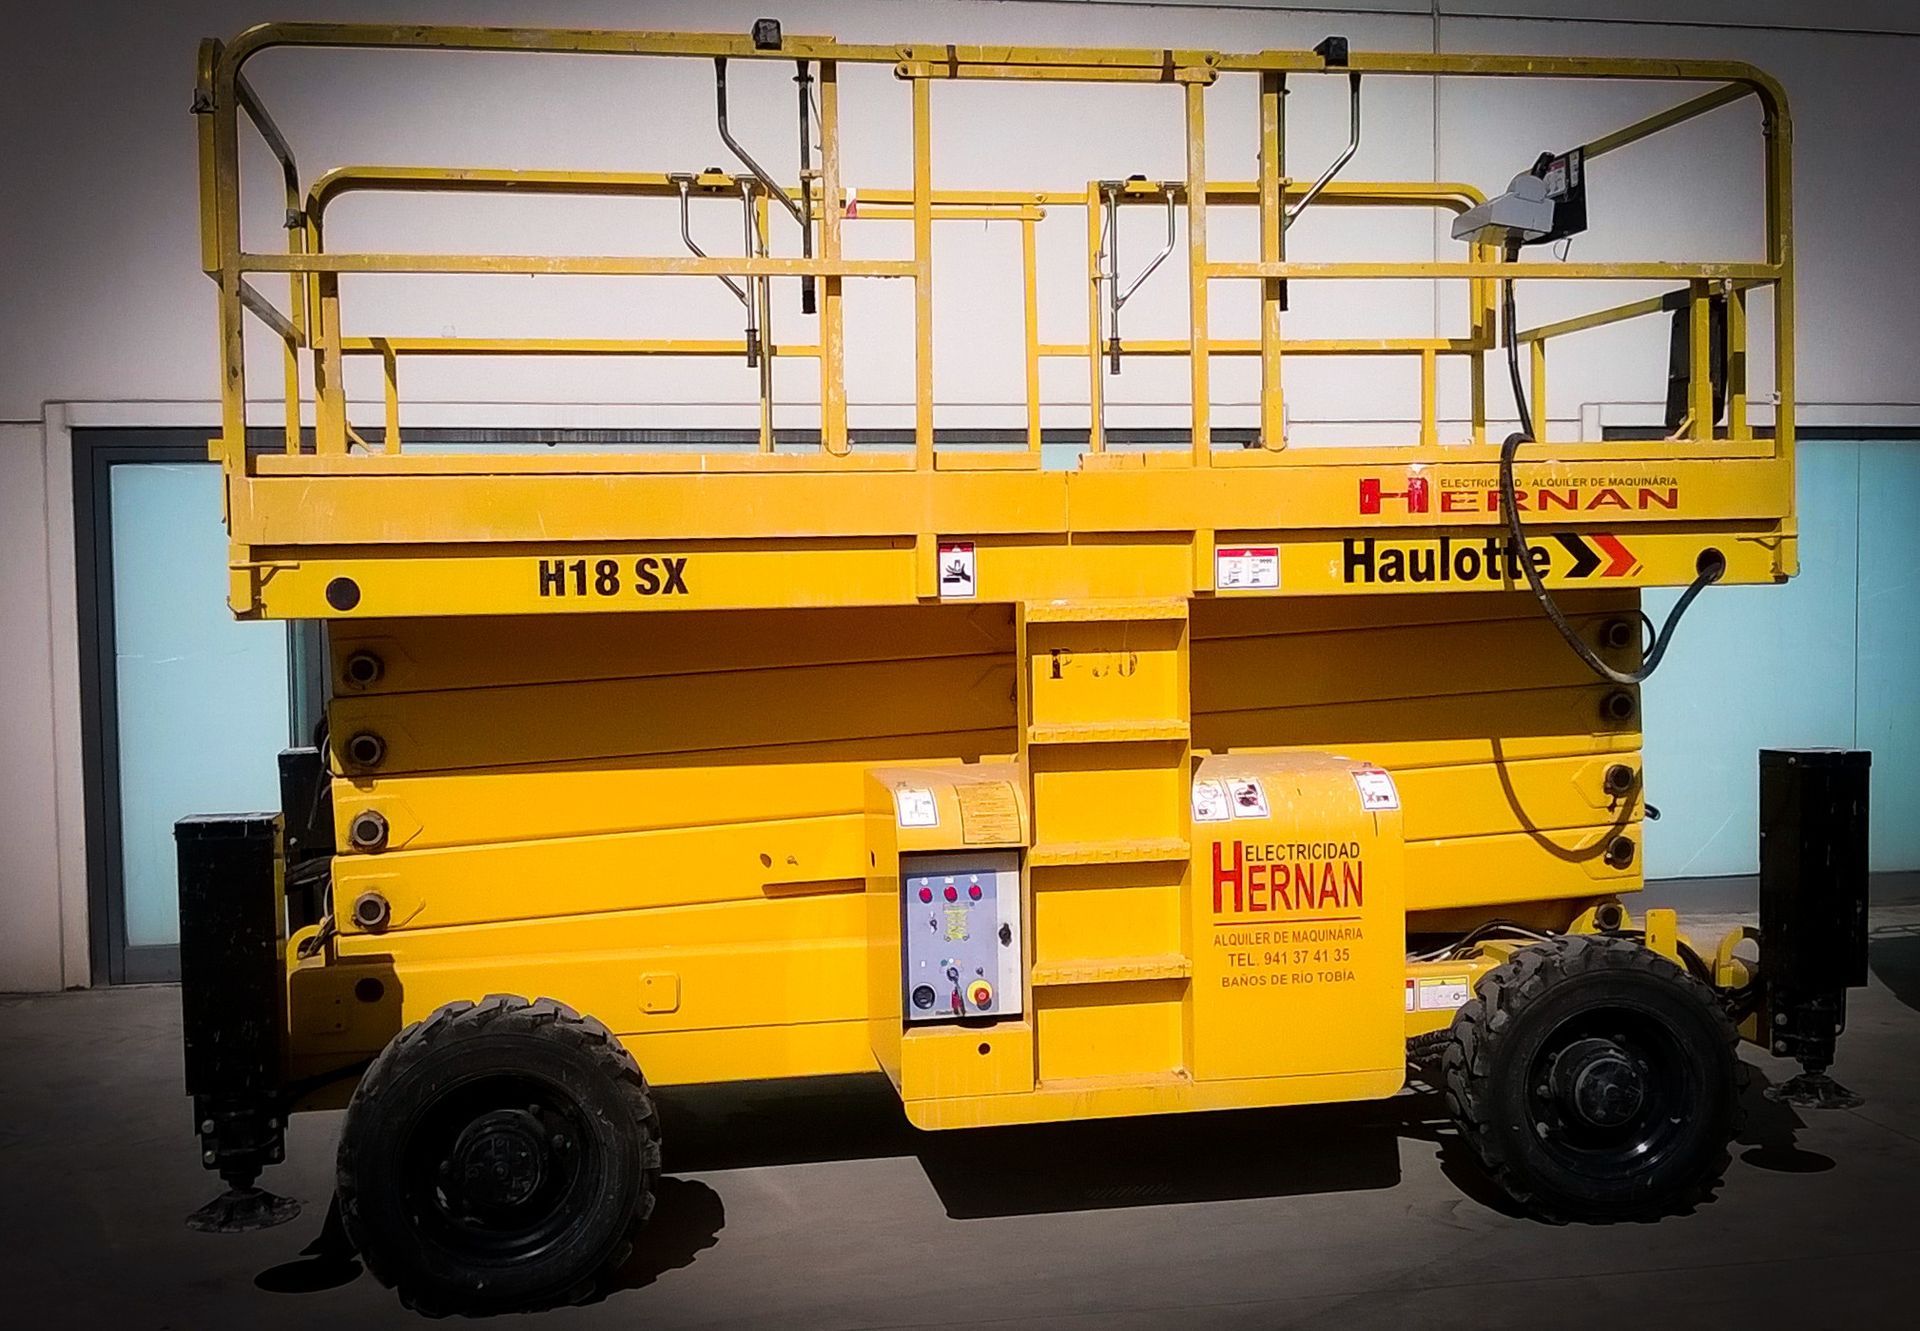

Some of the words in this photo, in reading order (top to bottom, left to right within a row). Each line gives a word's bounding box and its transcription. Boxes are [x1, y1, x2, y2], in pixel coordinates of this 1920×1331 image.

[1440, 477, 1522, 488] ELECTRICID
[1531, 477, 1588, 488] ALQUILER
[1590, 477, 1604, 488] DE
[1359, 477, 1679, 514] HERNAN
[1343, 536, 1551, 584] Haulotte
[539, 559, 620, 597] H18
[635, 557, 689, 596] SX
[1245, 842, 1361, 862] ELECTRICIDAD
[1212, 840, 1363, 914] HERNAN
[1213, 931, 1271, 947] ALQUILER
[1273, 930, 1289, 944] DE
[1228, 952, 1260, 968] TEL.
[1264, 951, 1288, 966] 941
[1293, 950, 1309, 965] 37
[1313, 949, 1329, 963] 41
[1334, 948, 1350, 962] 35
[1221, 973, 1267, 988] BAÑOS
[1271, 974, 1288, 985] DE
